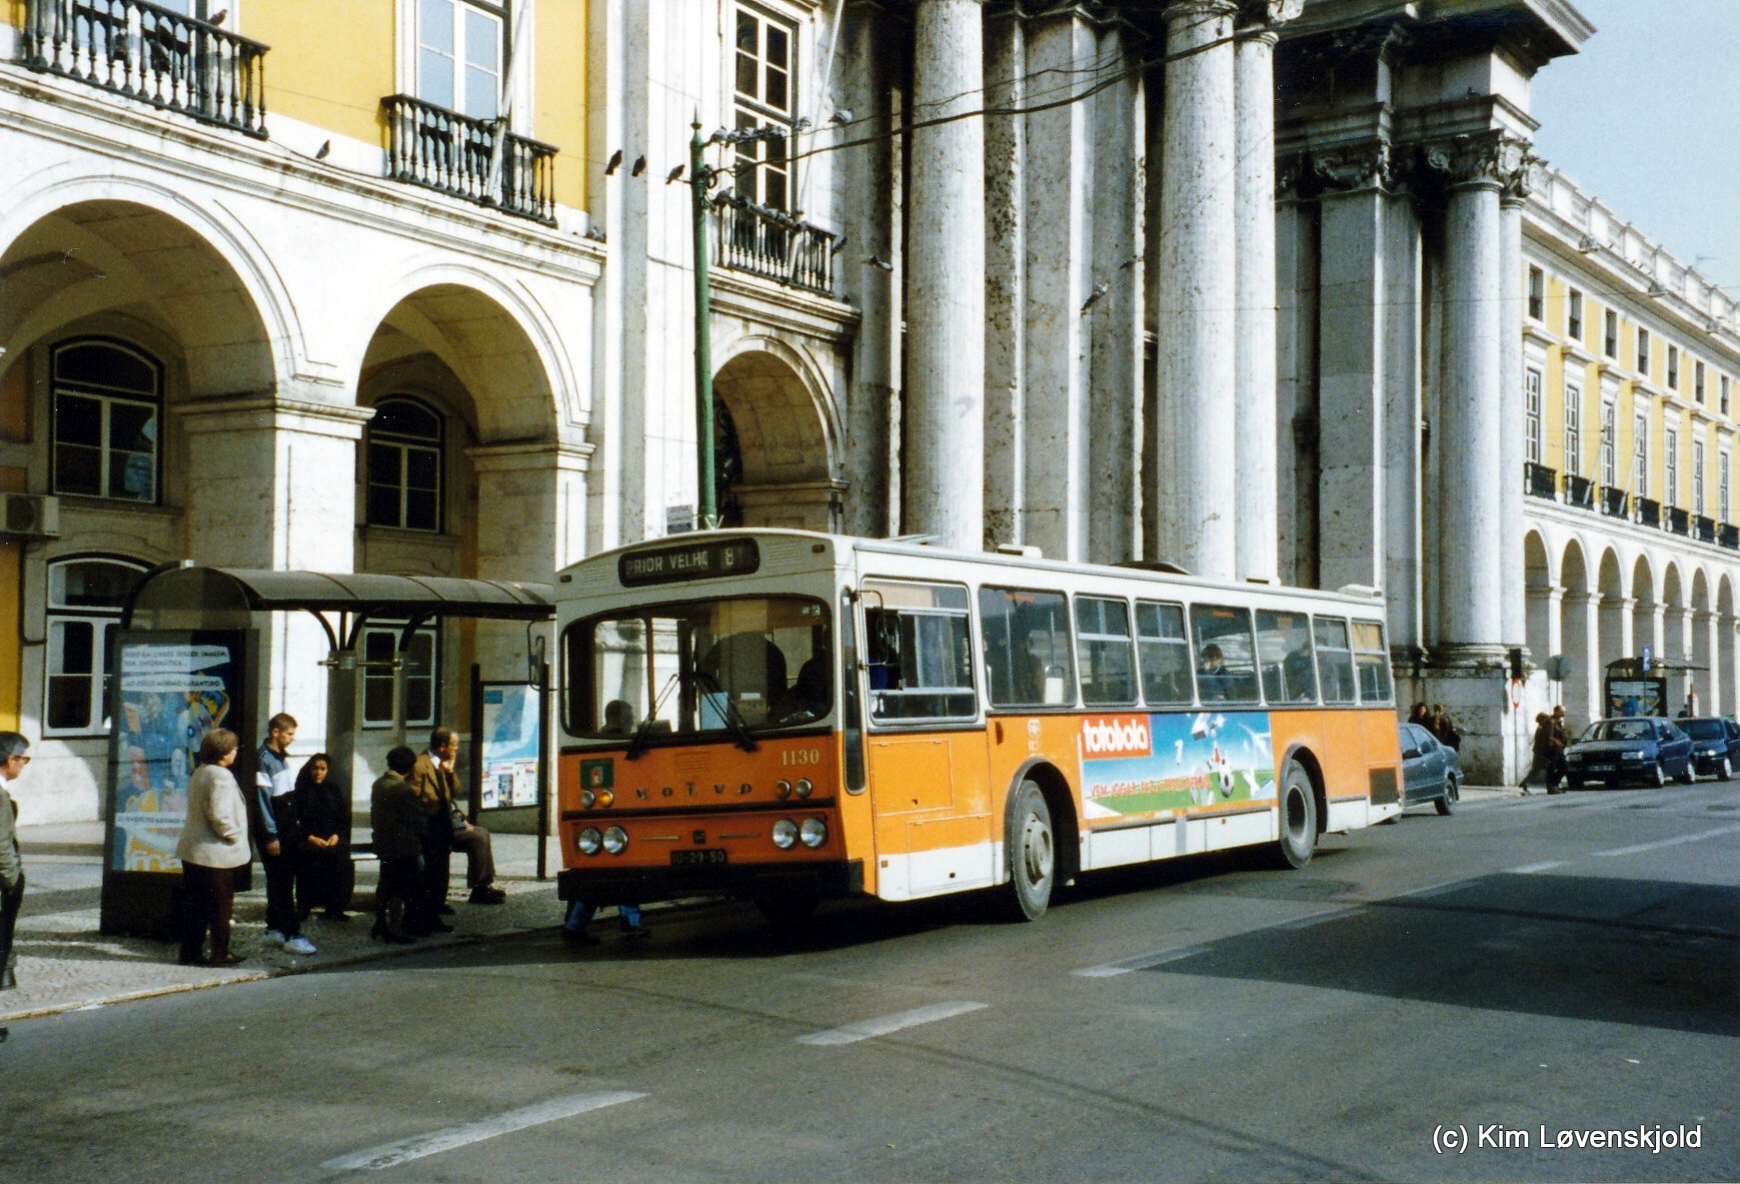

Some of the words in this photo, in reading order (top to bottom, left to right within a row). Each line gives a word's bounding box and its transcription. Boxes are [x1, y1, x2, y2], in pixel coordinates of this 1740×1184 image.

[626, 556, 663, 576] PRIOR
[1083, 719, 1148, 753] totobola
[782, 748, 820, 766] 1130
